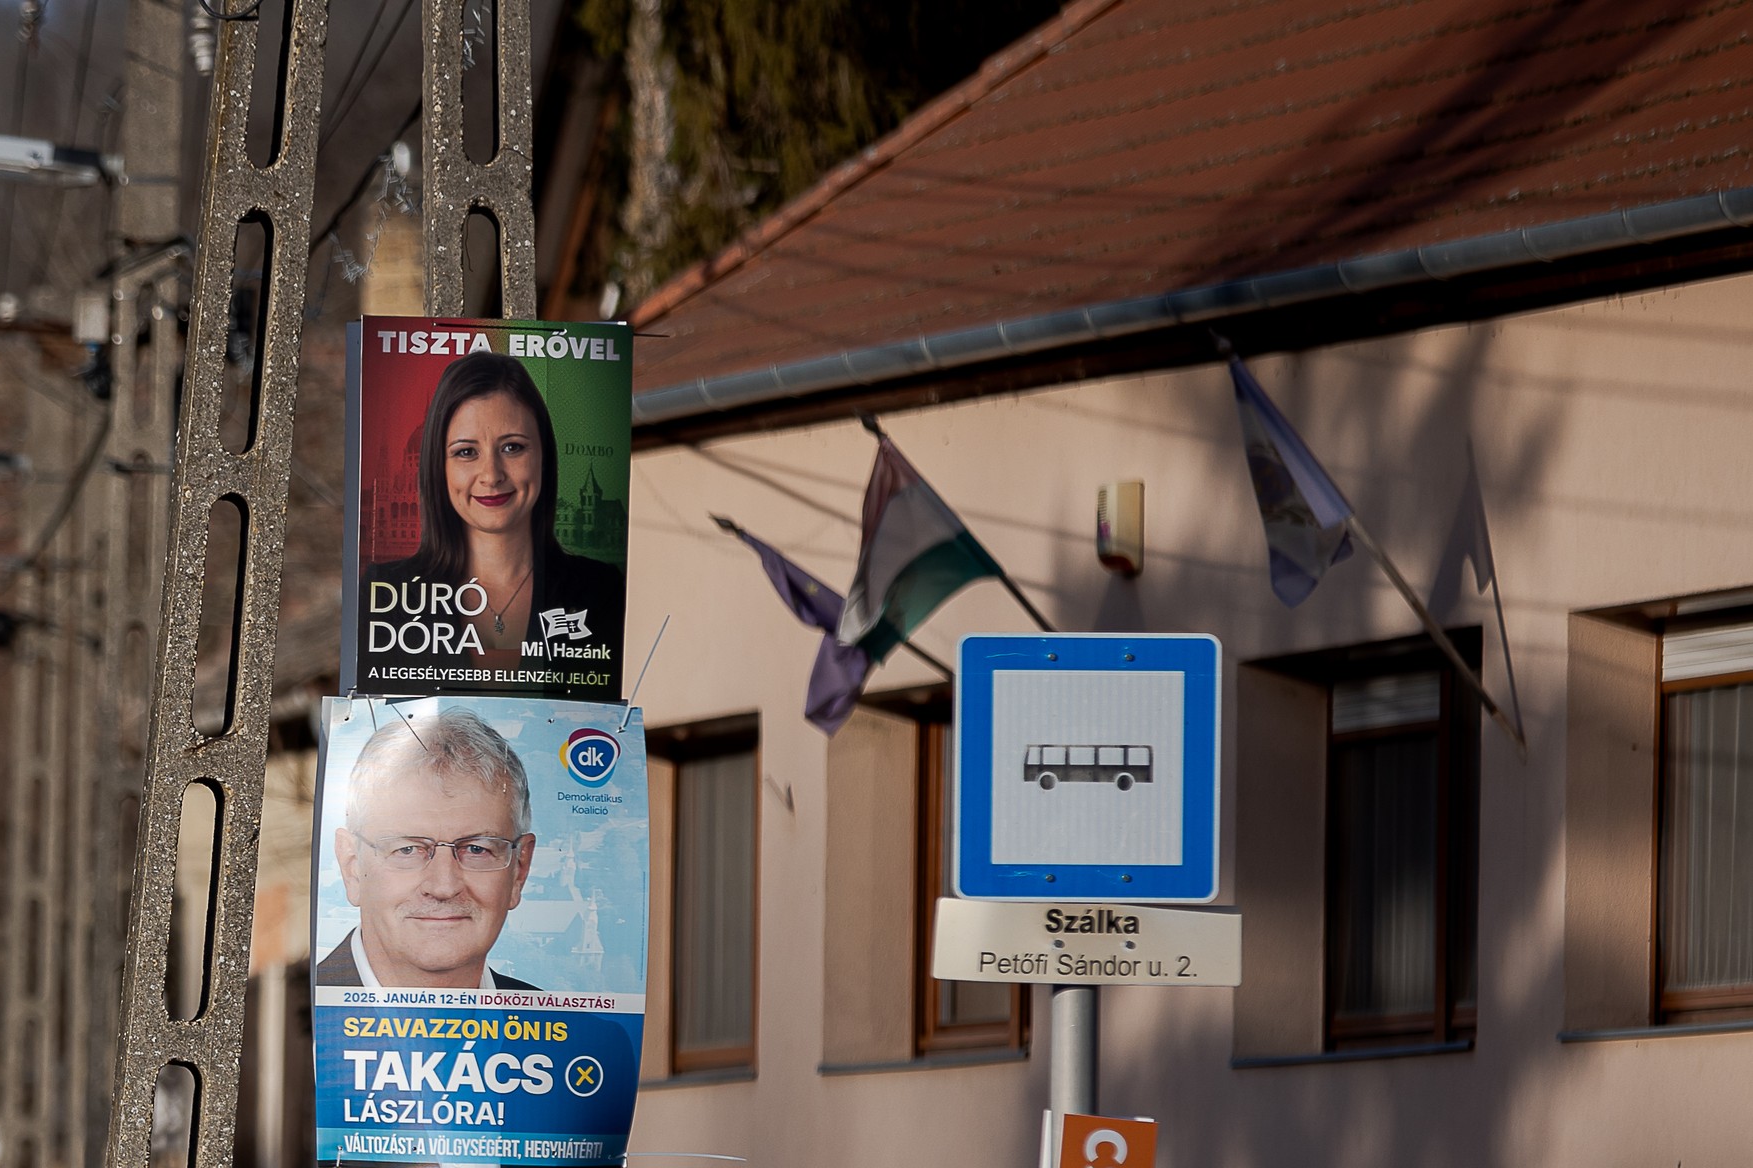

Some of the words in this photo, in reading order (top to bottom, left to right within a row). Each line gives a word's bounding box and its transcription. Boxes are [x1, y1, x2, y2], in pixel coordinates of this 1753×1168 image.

[377, 330, 492, 355] TISZTA
[509, 329, 620, 361] ERŐVEL
[369, 576, 488, 617] DÚRÓ
[368, 616, 485, 655] DÓRA
[521, 641, 543, 657] Mi
[553, 643, 611, 660] Hazánk
[368, 667, 379, 678] A
[382, 665, 491, 681] LEGESÉLYESEBB
[495, 669, 563, 684] ELLENZÉKI
[578, 747, 604, 767] dk
[557, 792, 623, 803] Demokratikus
[1045, 908, 1140, 934] Szálka
[978, 951, 1048, 976] Petőfi
[1056, 953, 1142, 977] Sándor
[1149, 960, 1169, 977] u.
[1177, 955, 1197, 978] 2.
[344, 993, 380, 1003] 2025.
[383, 992, 435, 1004] JANUÁR
[441, 992, 477, 1005] 12-ÉN
[480, 993, 533, 1007] IDŐKÖZI
[537, 994, 615, 1009] VÁLASZTÁS!
[343, 1017, 498, 1040] SZAVAZZON
[504, 1016, 540, 1041] ÖN
[545, 1022, 568, 1041] IS
[343, 1041, 553, 1095] TAKÁCS
[343, 1093, 505, 1126] LÁSZLÓRA!
[344, 1134, 413, 1155] VÁLTOZÁST
[416, 1140, 427, 1155] A
[429, 1135, 522, 1159] VÖLGYSÉGÉRT,
[525, 1140, 603, 1159] HEGYHÁTÉRT!
